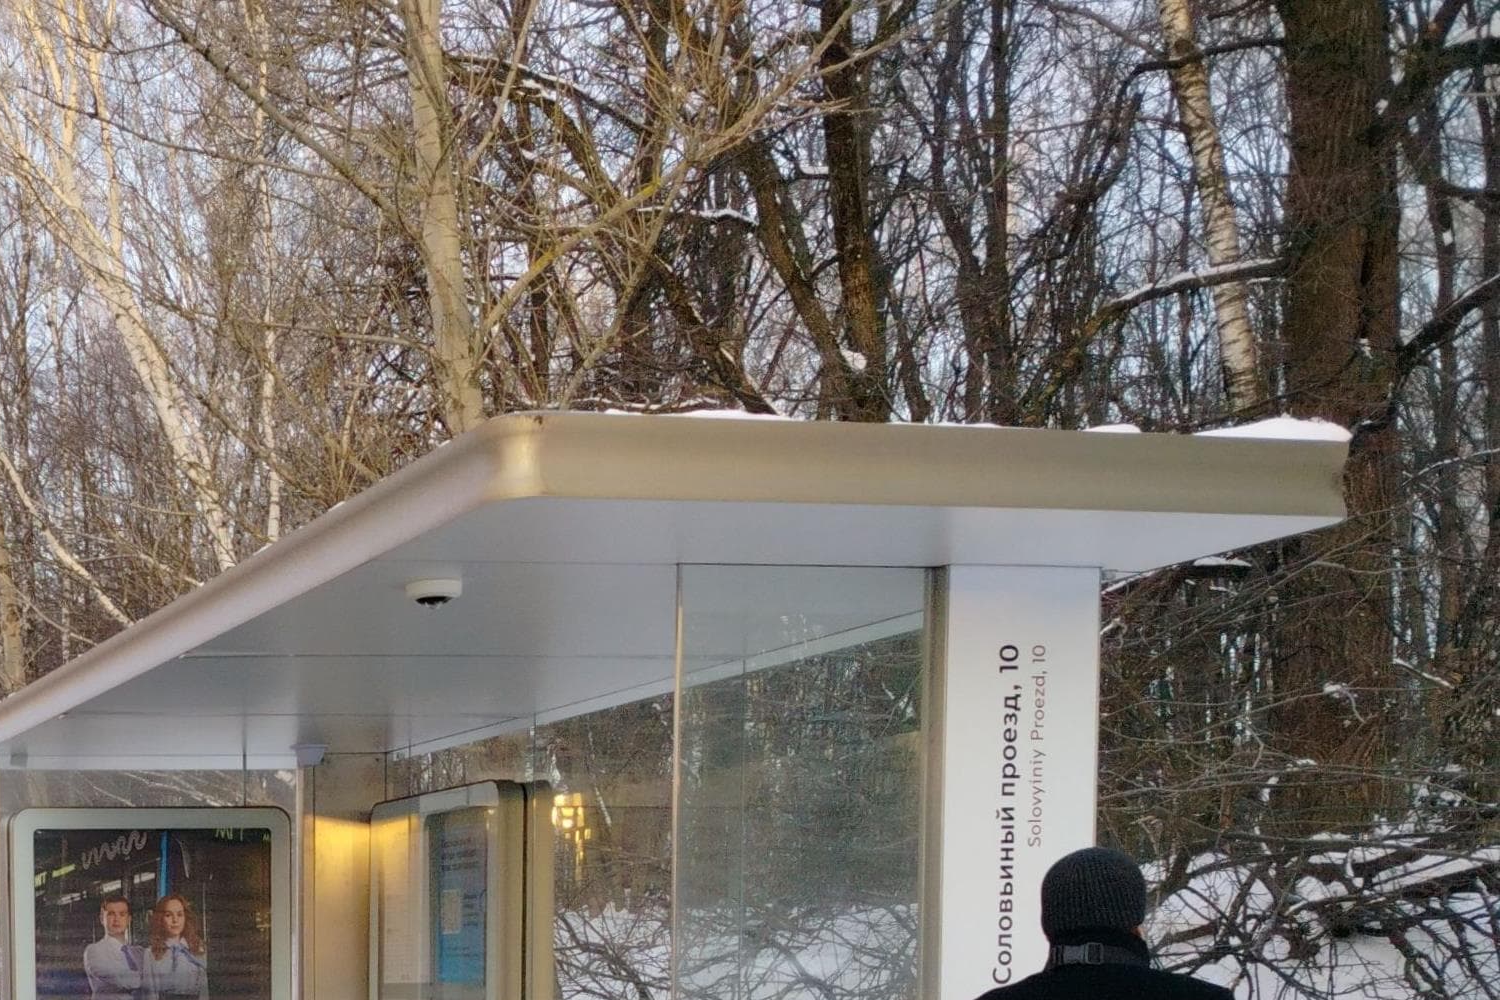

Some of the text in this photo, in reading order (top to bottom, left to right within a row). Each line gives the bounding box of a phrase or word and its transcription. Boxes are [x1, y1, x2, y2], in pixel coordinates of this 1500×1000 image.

[992, 644, 1023, 985] Соловьиный проезд, 10
[1028, 644, 1048, 848] Solovyiniy Proezd, 10
